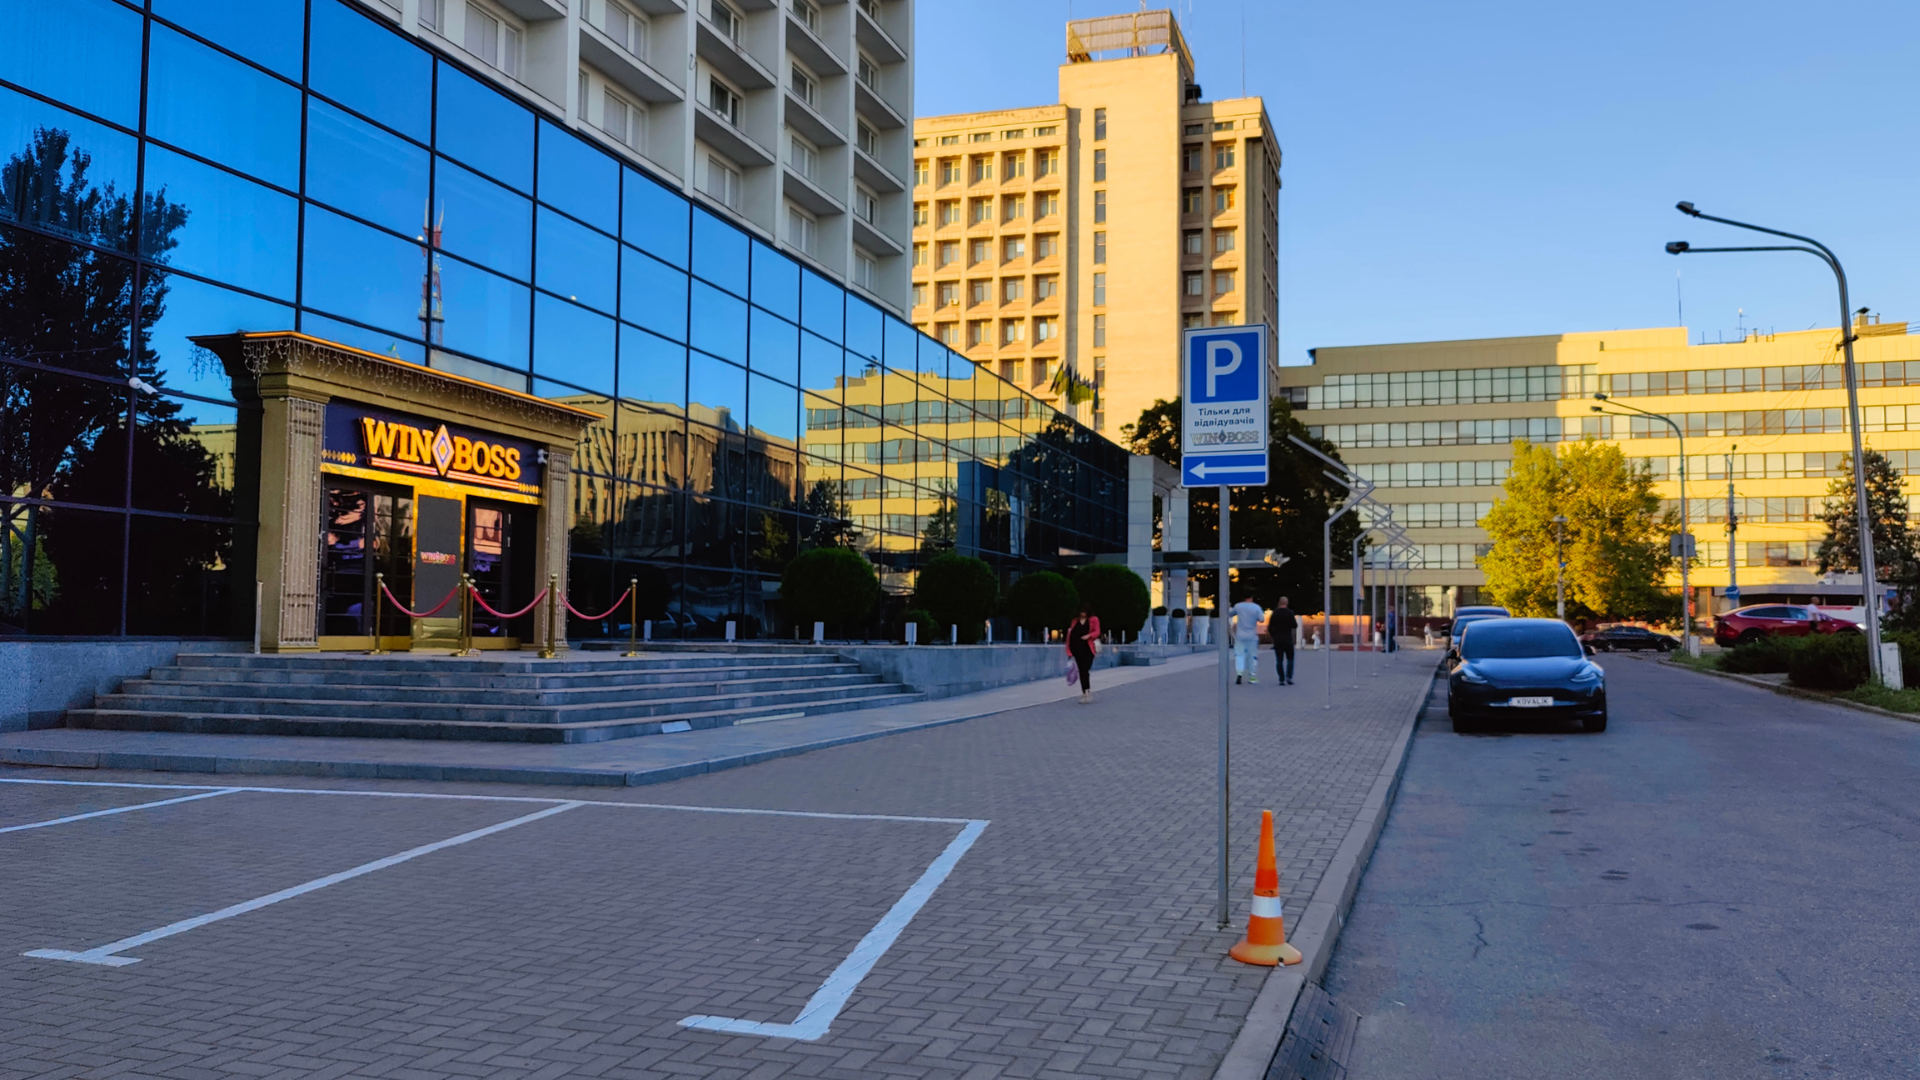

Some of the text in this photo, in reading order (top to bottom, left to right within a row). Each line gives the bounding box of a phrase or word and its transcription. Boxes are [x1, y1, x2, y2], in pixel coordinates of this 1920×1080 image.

[1206, 340, 1242, 397] P
[1198, 407, 1251, 416] Тільки для
[1194, 417, 1254, 427] відвідувачів
[1190, 431, 1259, 444] WIN BOSS
[362, 417, 521, 481] WIN BOSS
